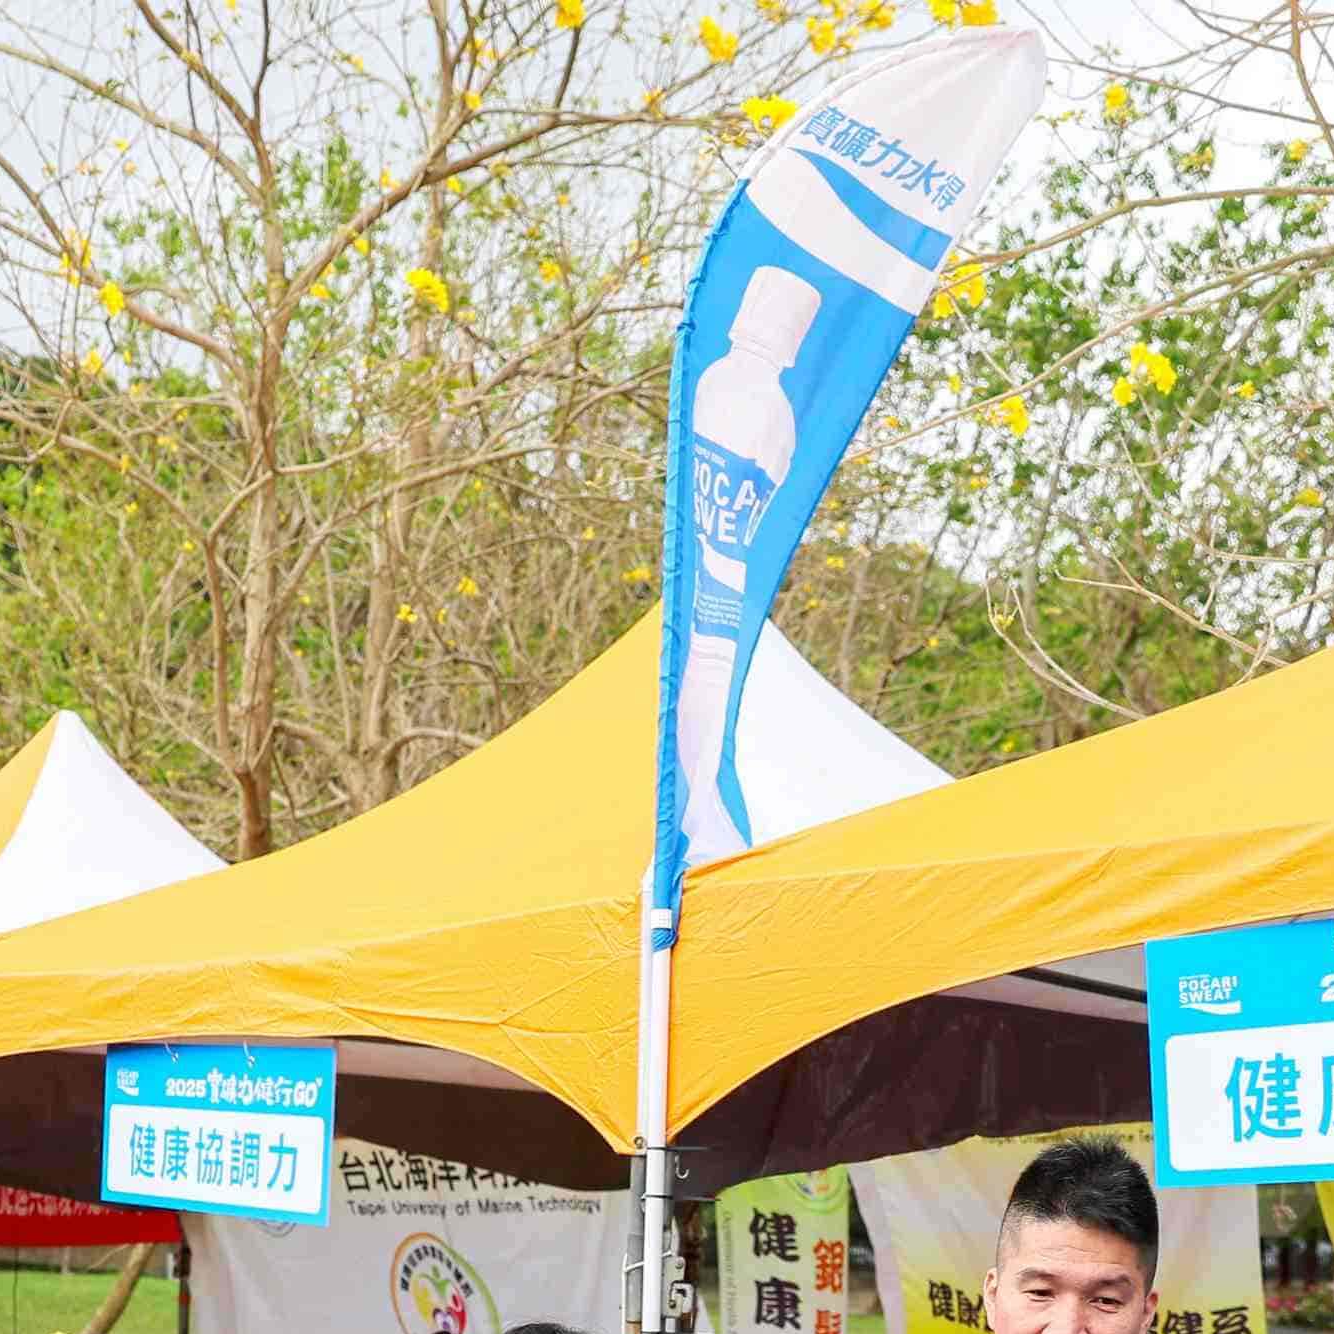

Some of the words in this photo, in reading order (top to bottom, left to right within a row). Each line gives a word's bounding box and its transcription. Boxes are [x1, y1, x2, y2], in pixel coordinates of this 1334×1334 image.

[800, 105, 965, 211] 寶礦力水得
[1179, 976, 1238, 993] POCARI
[129, 1122, 299, 1193] 健康協調力
